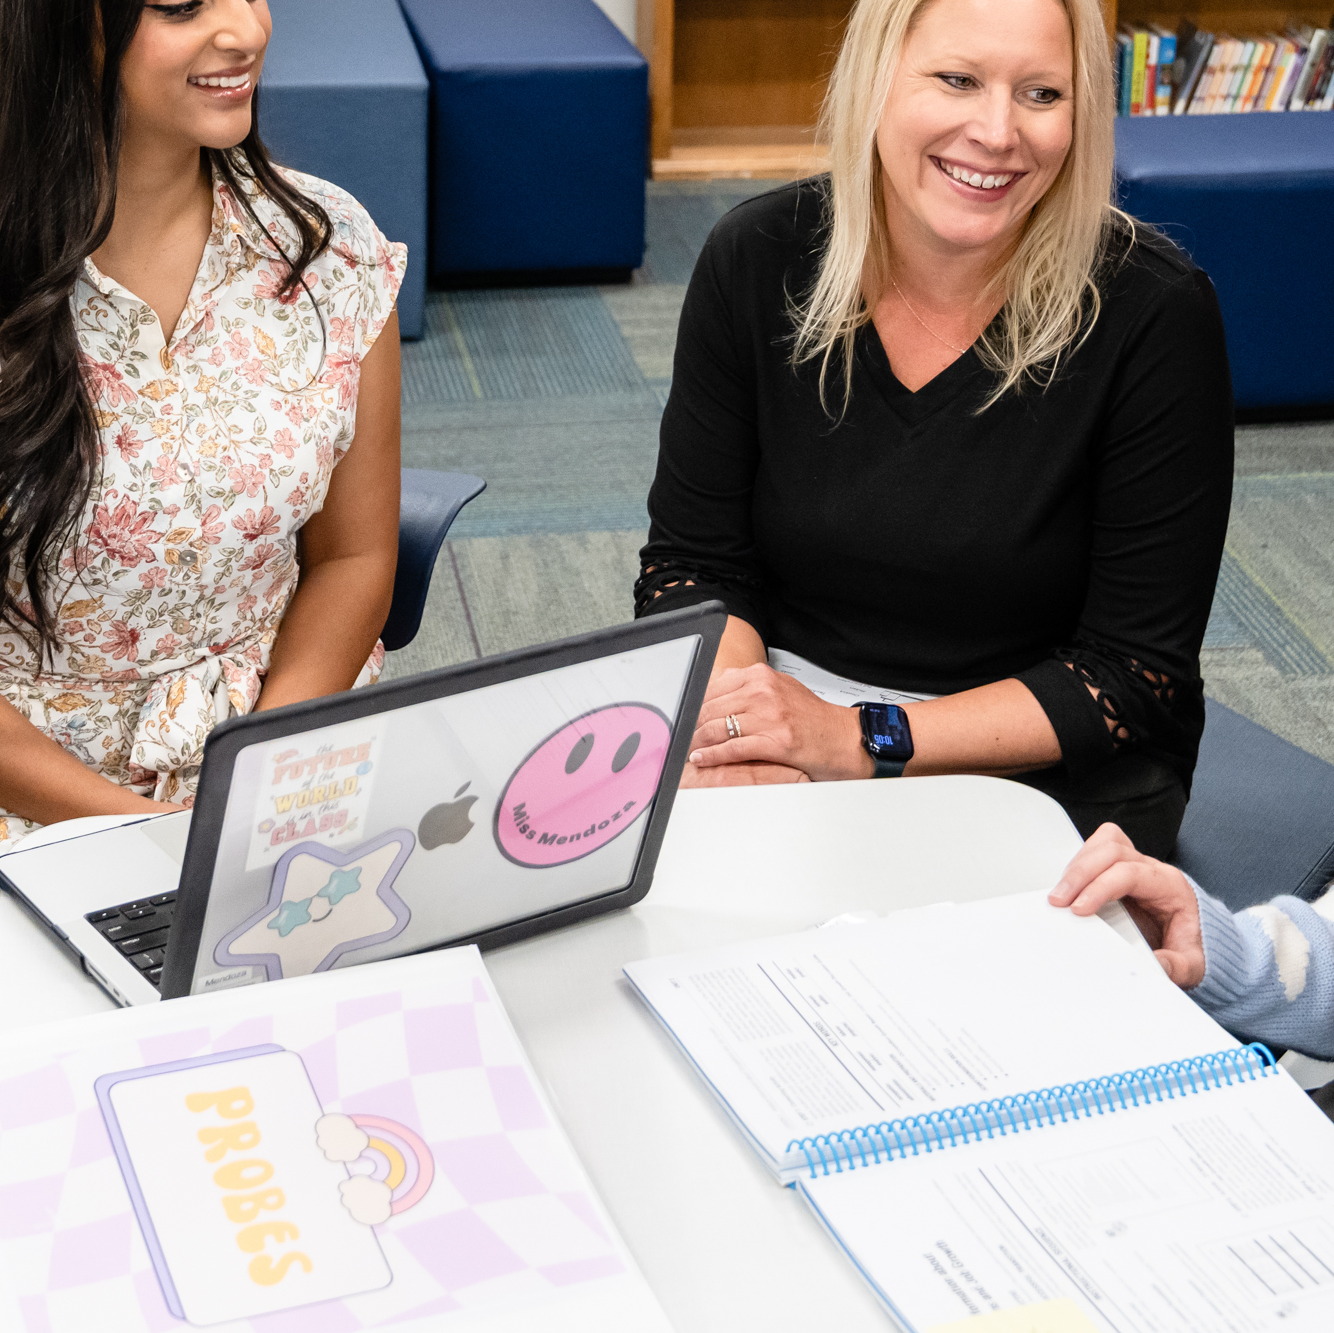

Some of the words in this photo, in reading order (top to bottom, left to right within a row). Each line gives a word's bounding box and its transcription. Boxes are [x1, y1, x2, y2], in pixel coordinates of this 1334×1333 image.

[315, 743, 335, 756] the
[873, 734, 894, 746] 10:05
[271, 741, 373, 785] FUTURE
[317, 771, 336, 785] the
[273, 775, 359, 815] WORLD
[317, 800, 341, 815] this
[269, 808, 350, 847] CLASS
[512, 801, 537, 841] Miss
[536, 799, 638, 846] Mendoza
[204, 969, 248, 987] Mendoza
[184, 1085, 315, 1287] PROBES
